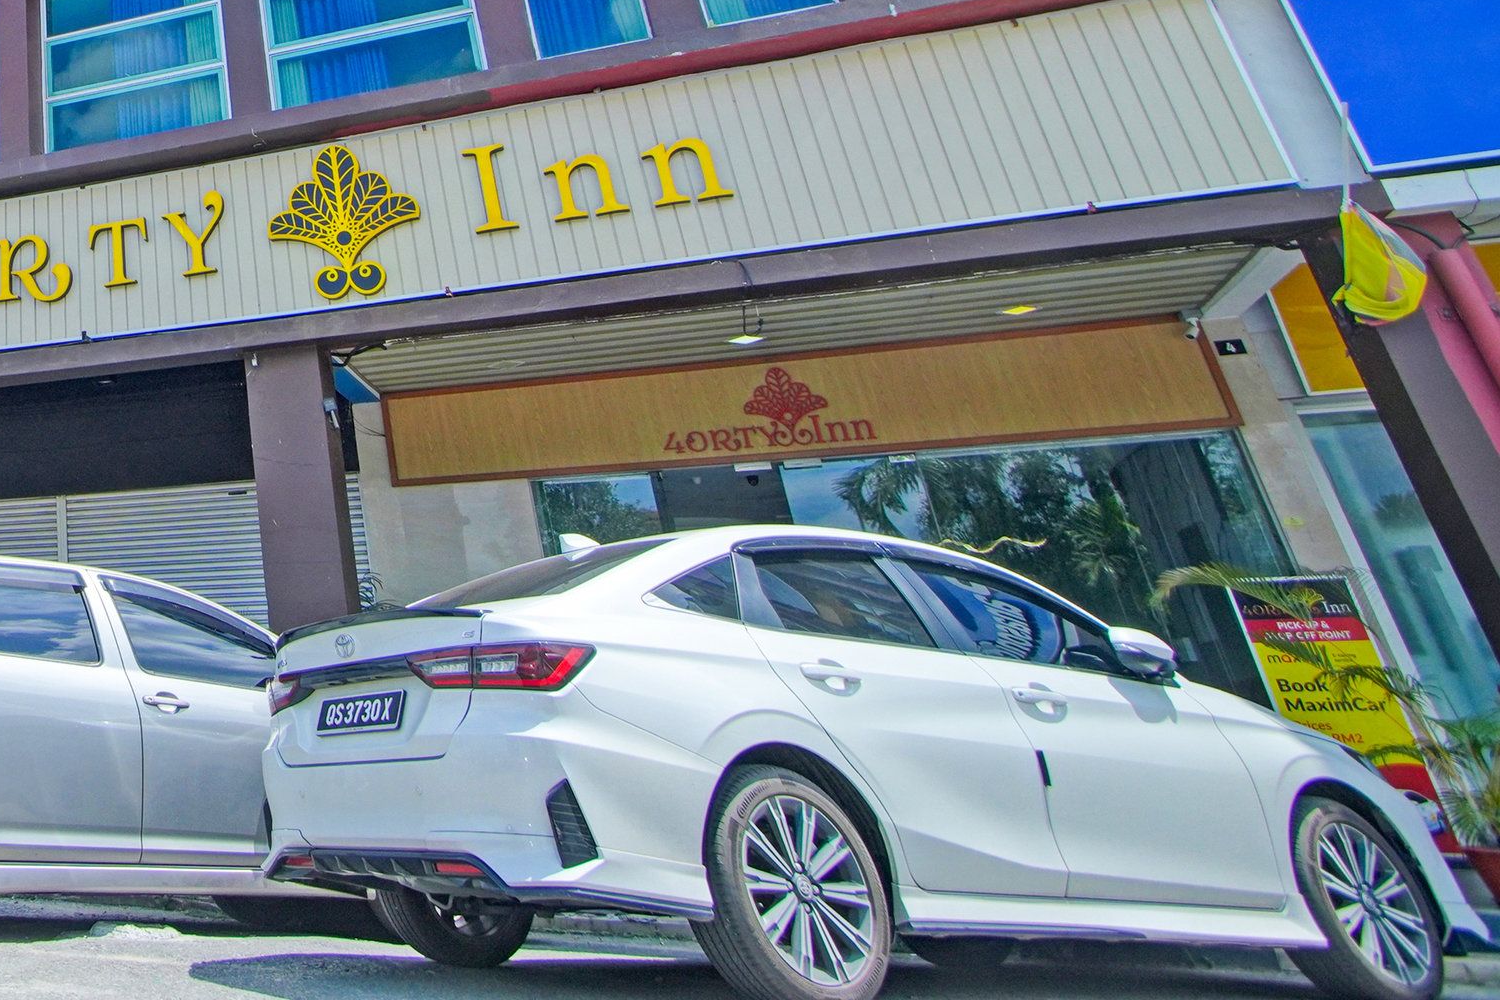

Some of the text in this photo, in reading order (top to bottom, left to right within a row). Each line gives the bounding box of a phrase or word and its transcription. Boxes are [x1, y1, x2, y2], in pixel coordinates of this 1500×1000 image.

[462, 136, 734, 234] Inn
[1226, 342, 1237, 353] 4
[663, 414, 878, 454] 4ORTY Inn
[1322, 600, 1352, 614] Inn
[1276, 621, 1330, 630] PICK-UP &
[1319, 630, 1352, 640] POINT
[1276, 678, 1330, 692] Book
[1283, 697, 1386, 712] MaximCar
